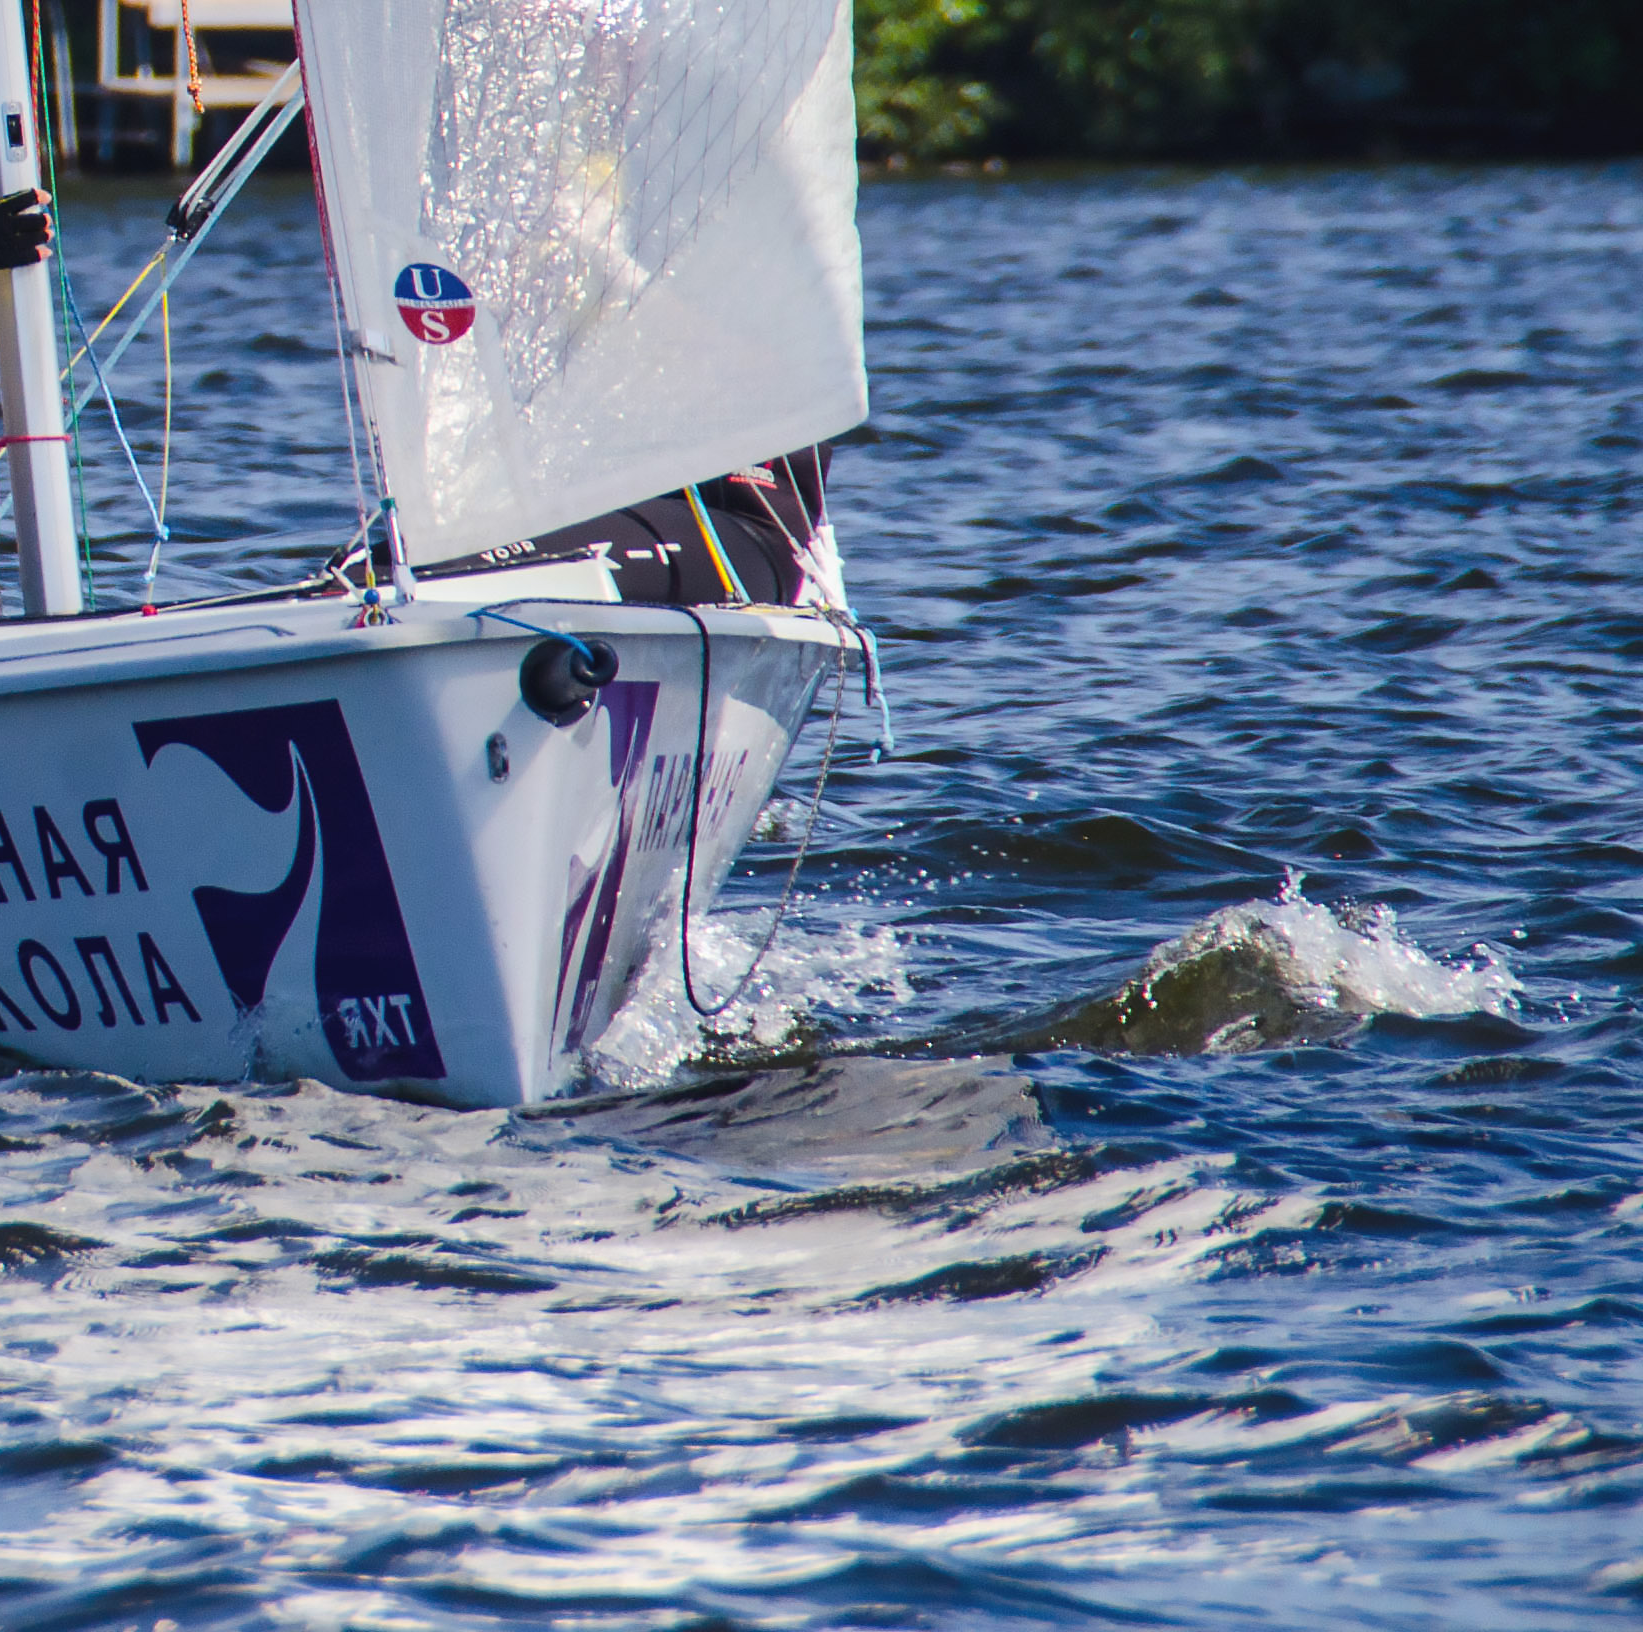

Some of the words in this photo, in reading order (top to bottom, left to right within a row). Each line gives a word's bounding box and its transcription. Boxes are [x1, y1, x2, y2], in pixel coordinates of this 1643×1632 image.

[410, 267, 443, 299] U
[421, 310, 450, 342] S
[337, 994, 417, 1048] ЯХТ
